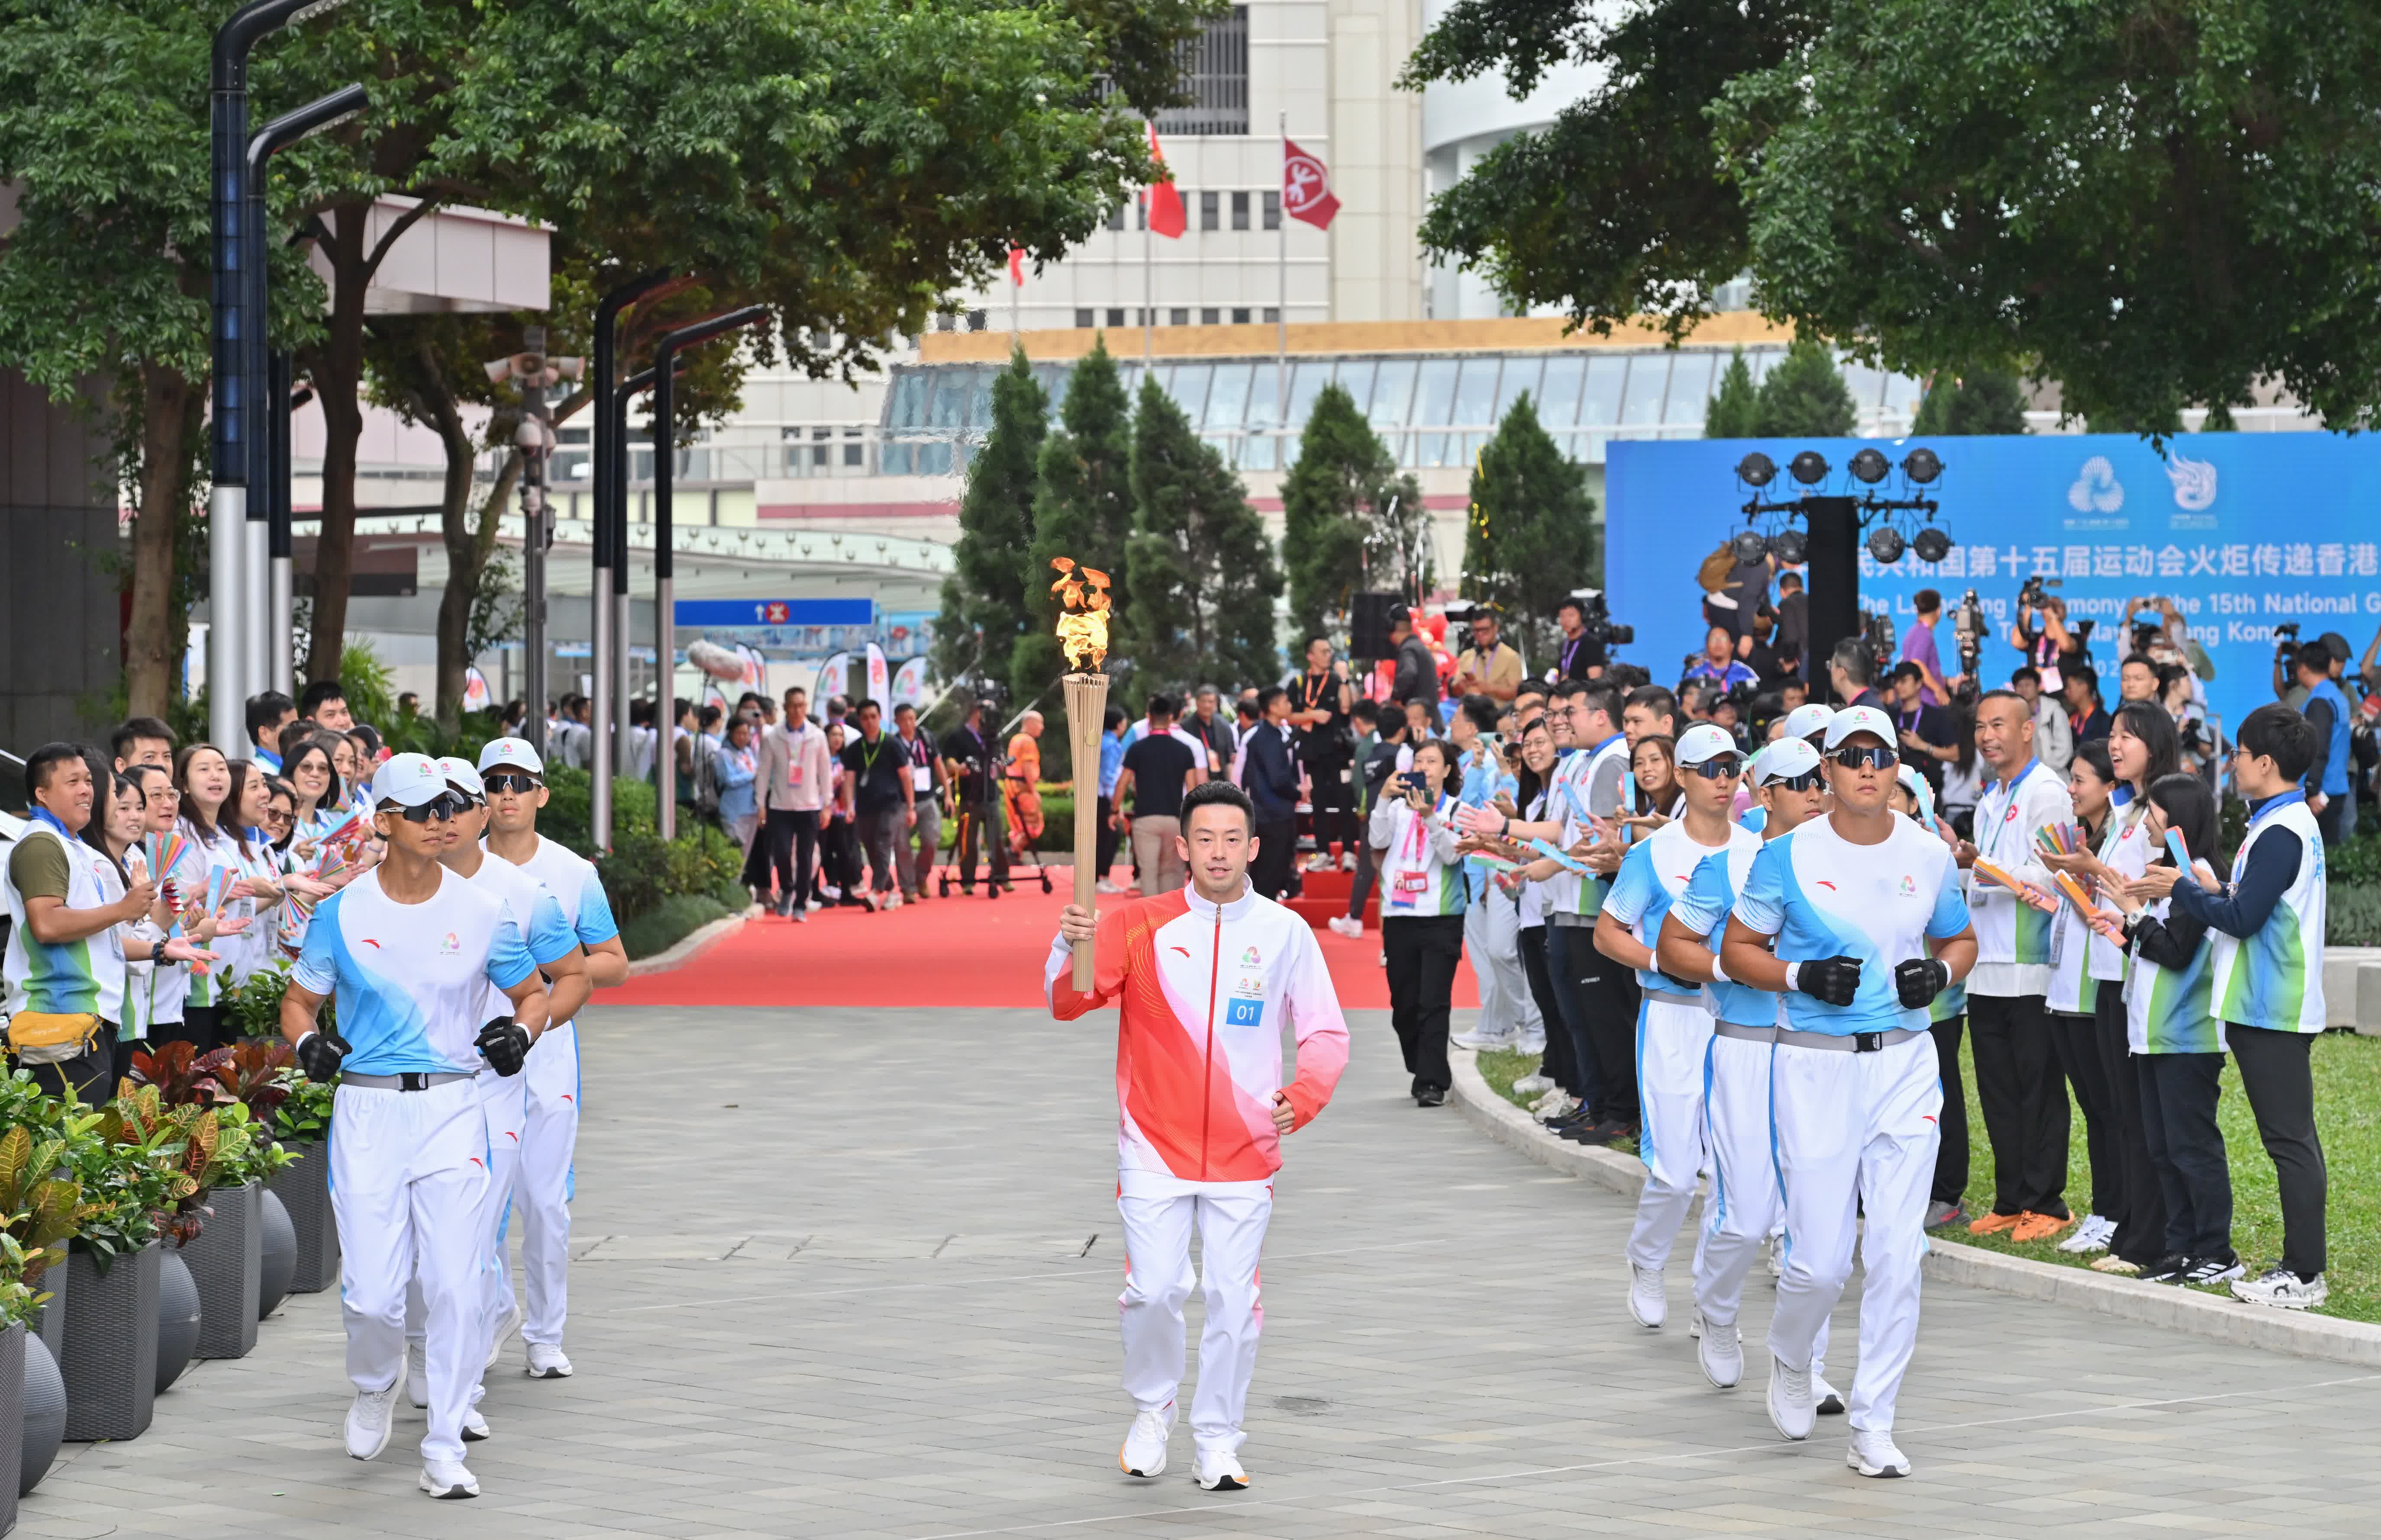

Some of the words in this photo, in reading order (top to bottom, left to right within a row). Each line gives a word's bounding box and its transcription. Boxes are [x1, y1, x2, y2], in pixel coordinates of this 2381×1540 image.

[2210, 593, 2256, 614] 15th
[2264, 591, 2357, 614] National
[1237, 1005, 1254, 1020] 01
